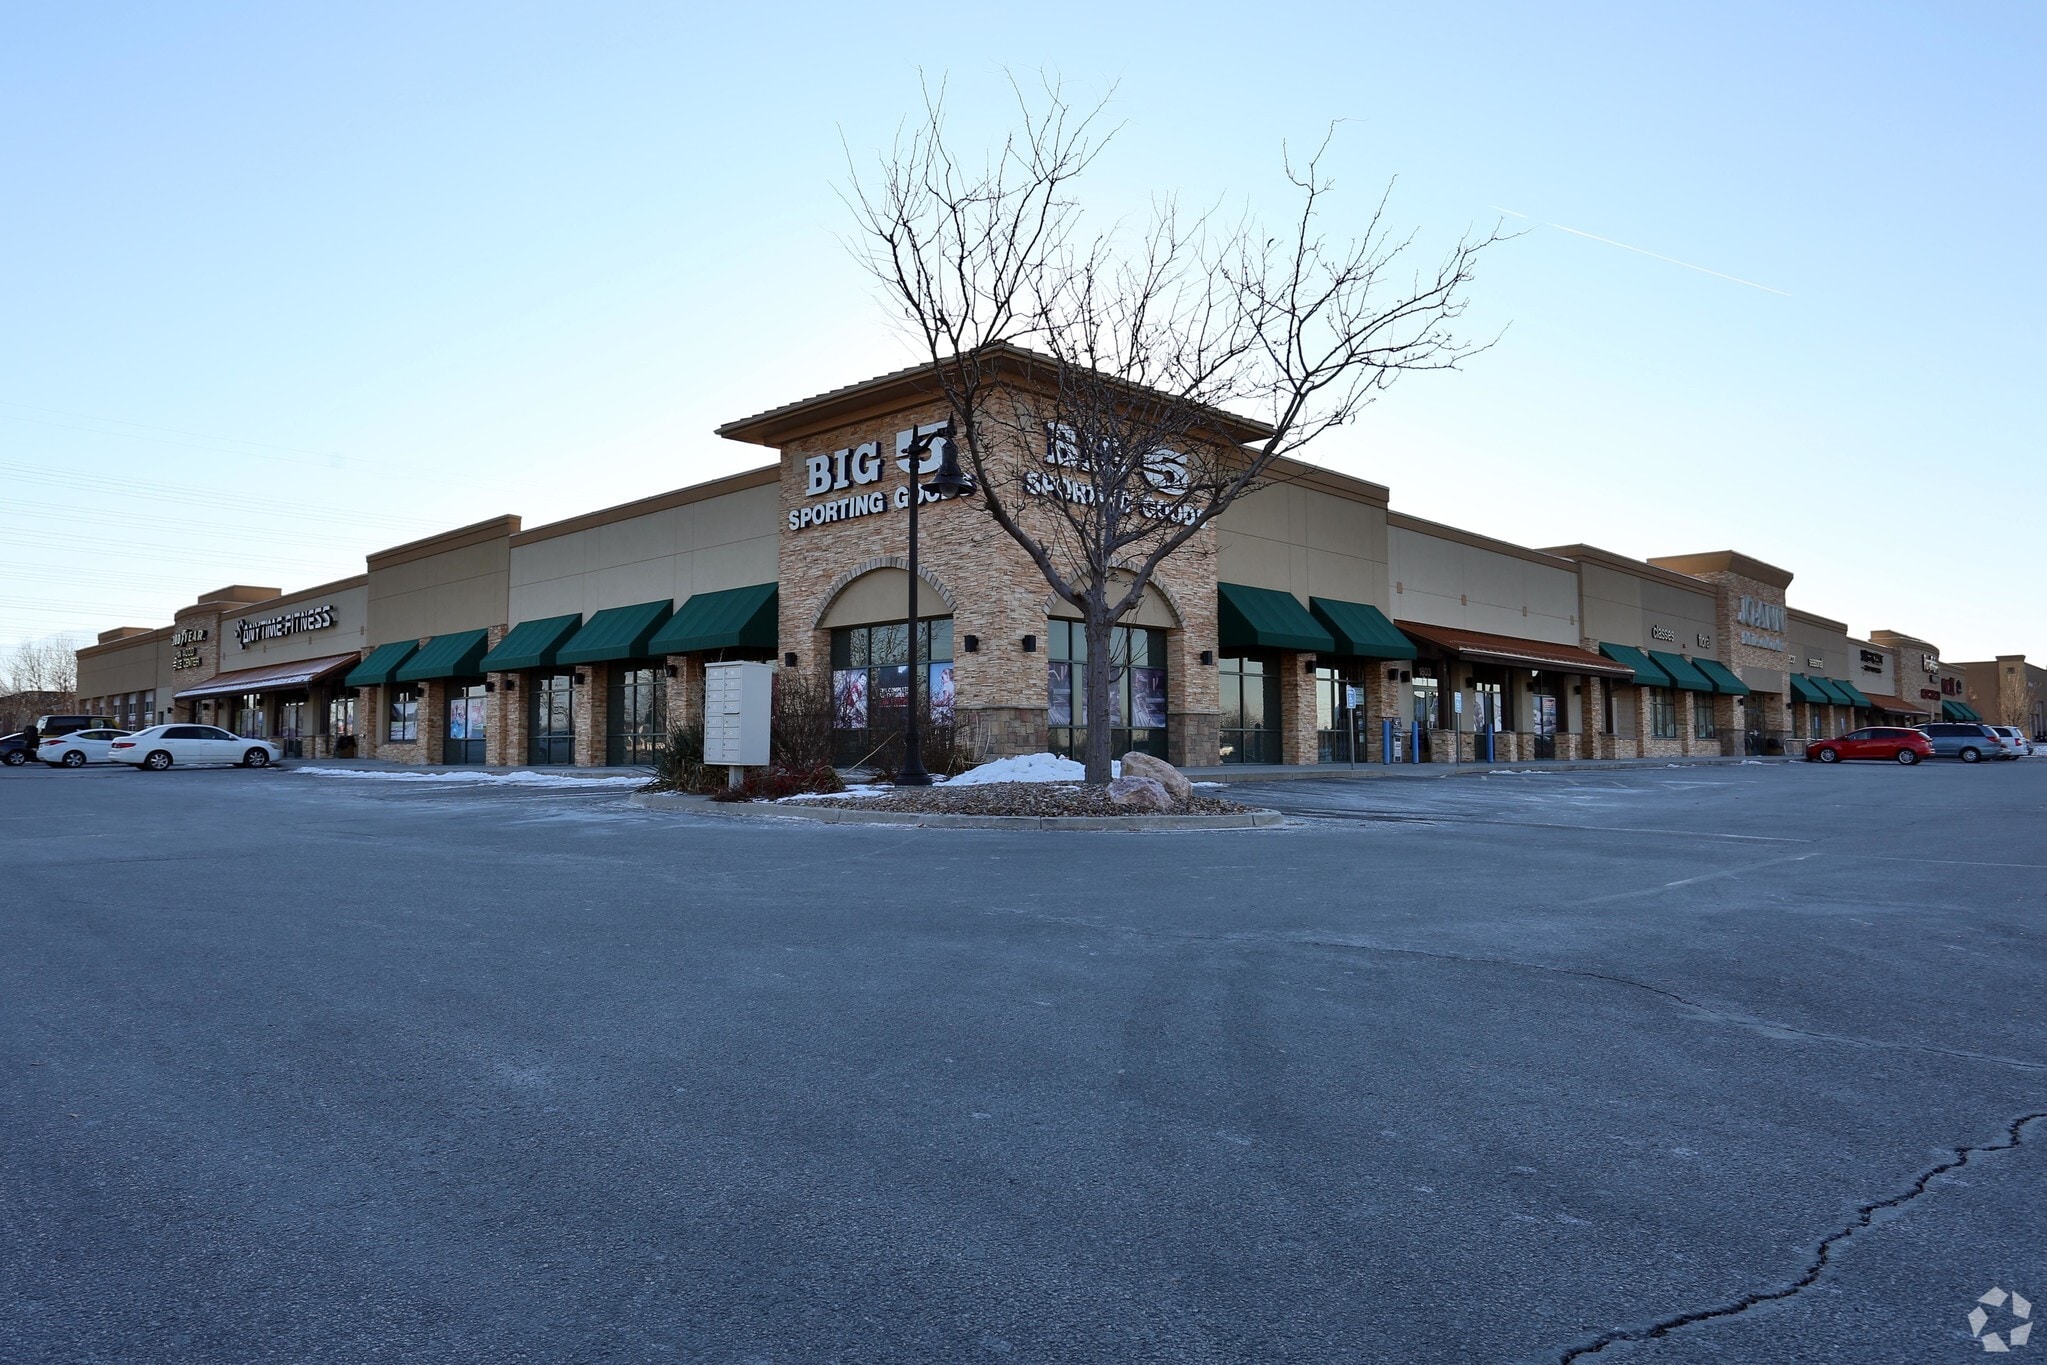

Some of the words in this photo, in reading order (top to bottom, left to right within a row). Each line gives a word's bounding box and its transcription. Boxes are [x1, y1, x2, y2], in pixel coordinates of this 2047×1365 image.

[806, 441, 881, 496] BIG
[895, 420, 948, 475] 5
[788, 491, 884, 531] SPORTING
[243, 616, 282, 643] ANYTIME
[284, 605, 331, 635] FITNESS
[1652, 624, 1675, 642] classes
